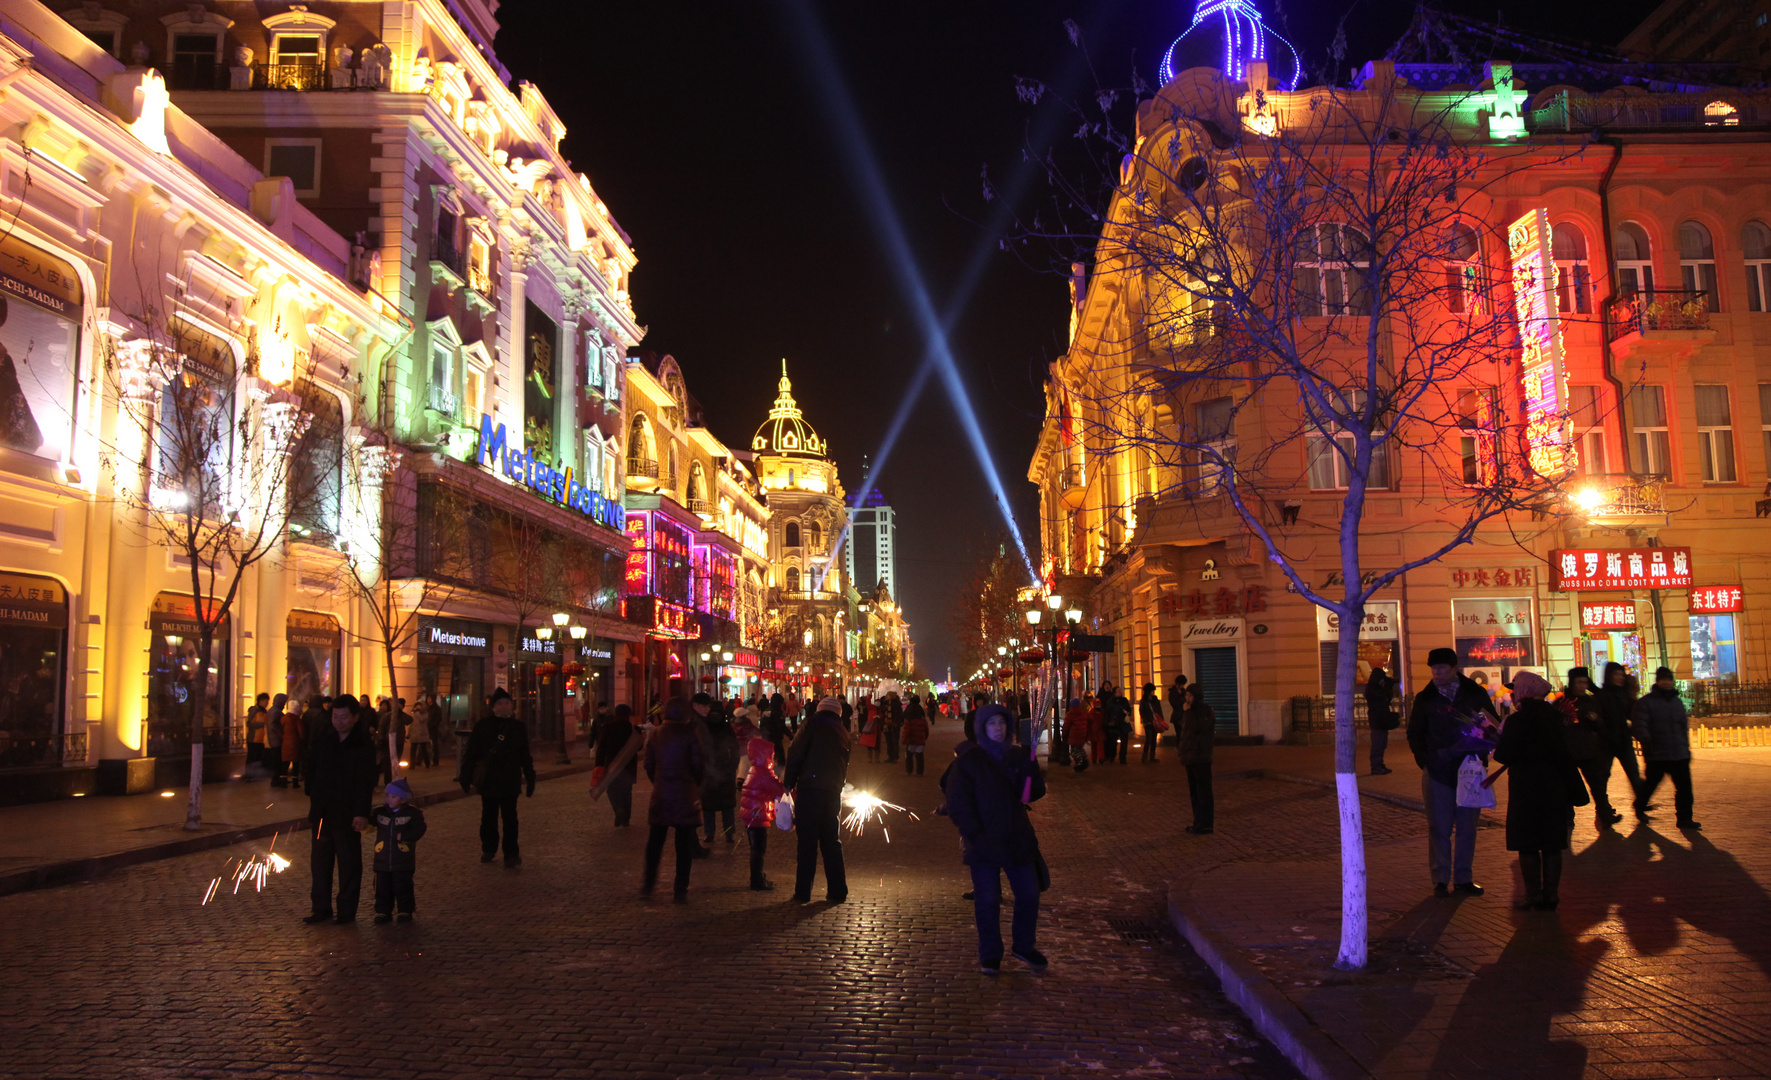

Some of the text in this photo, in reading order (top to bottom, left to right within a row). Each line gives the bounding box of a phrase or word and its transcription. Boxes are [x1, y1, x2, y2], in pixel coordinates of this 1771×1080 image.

[1561, 551, 1689, 579] 俄罗斯商品城
[1453, 567, 1532, 589] 中央金店
[1560, 577, 1692, 588] RUSSIAN COMMODITY MARKET
[1161, 584, 1269, 618] 中央金店
[1691, 589, 1742, 609] 东北特产
[1458, 612, 1525, 625] 中央 金店
[1582, 605, 1636, 626] 俄罗斯商品
[1183, 621, 1239, 639] Jewellery
